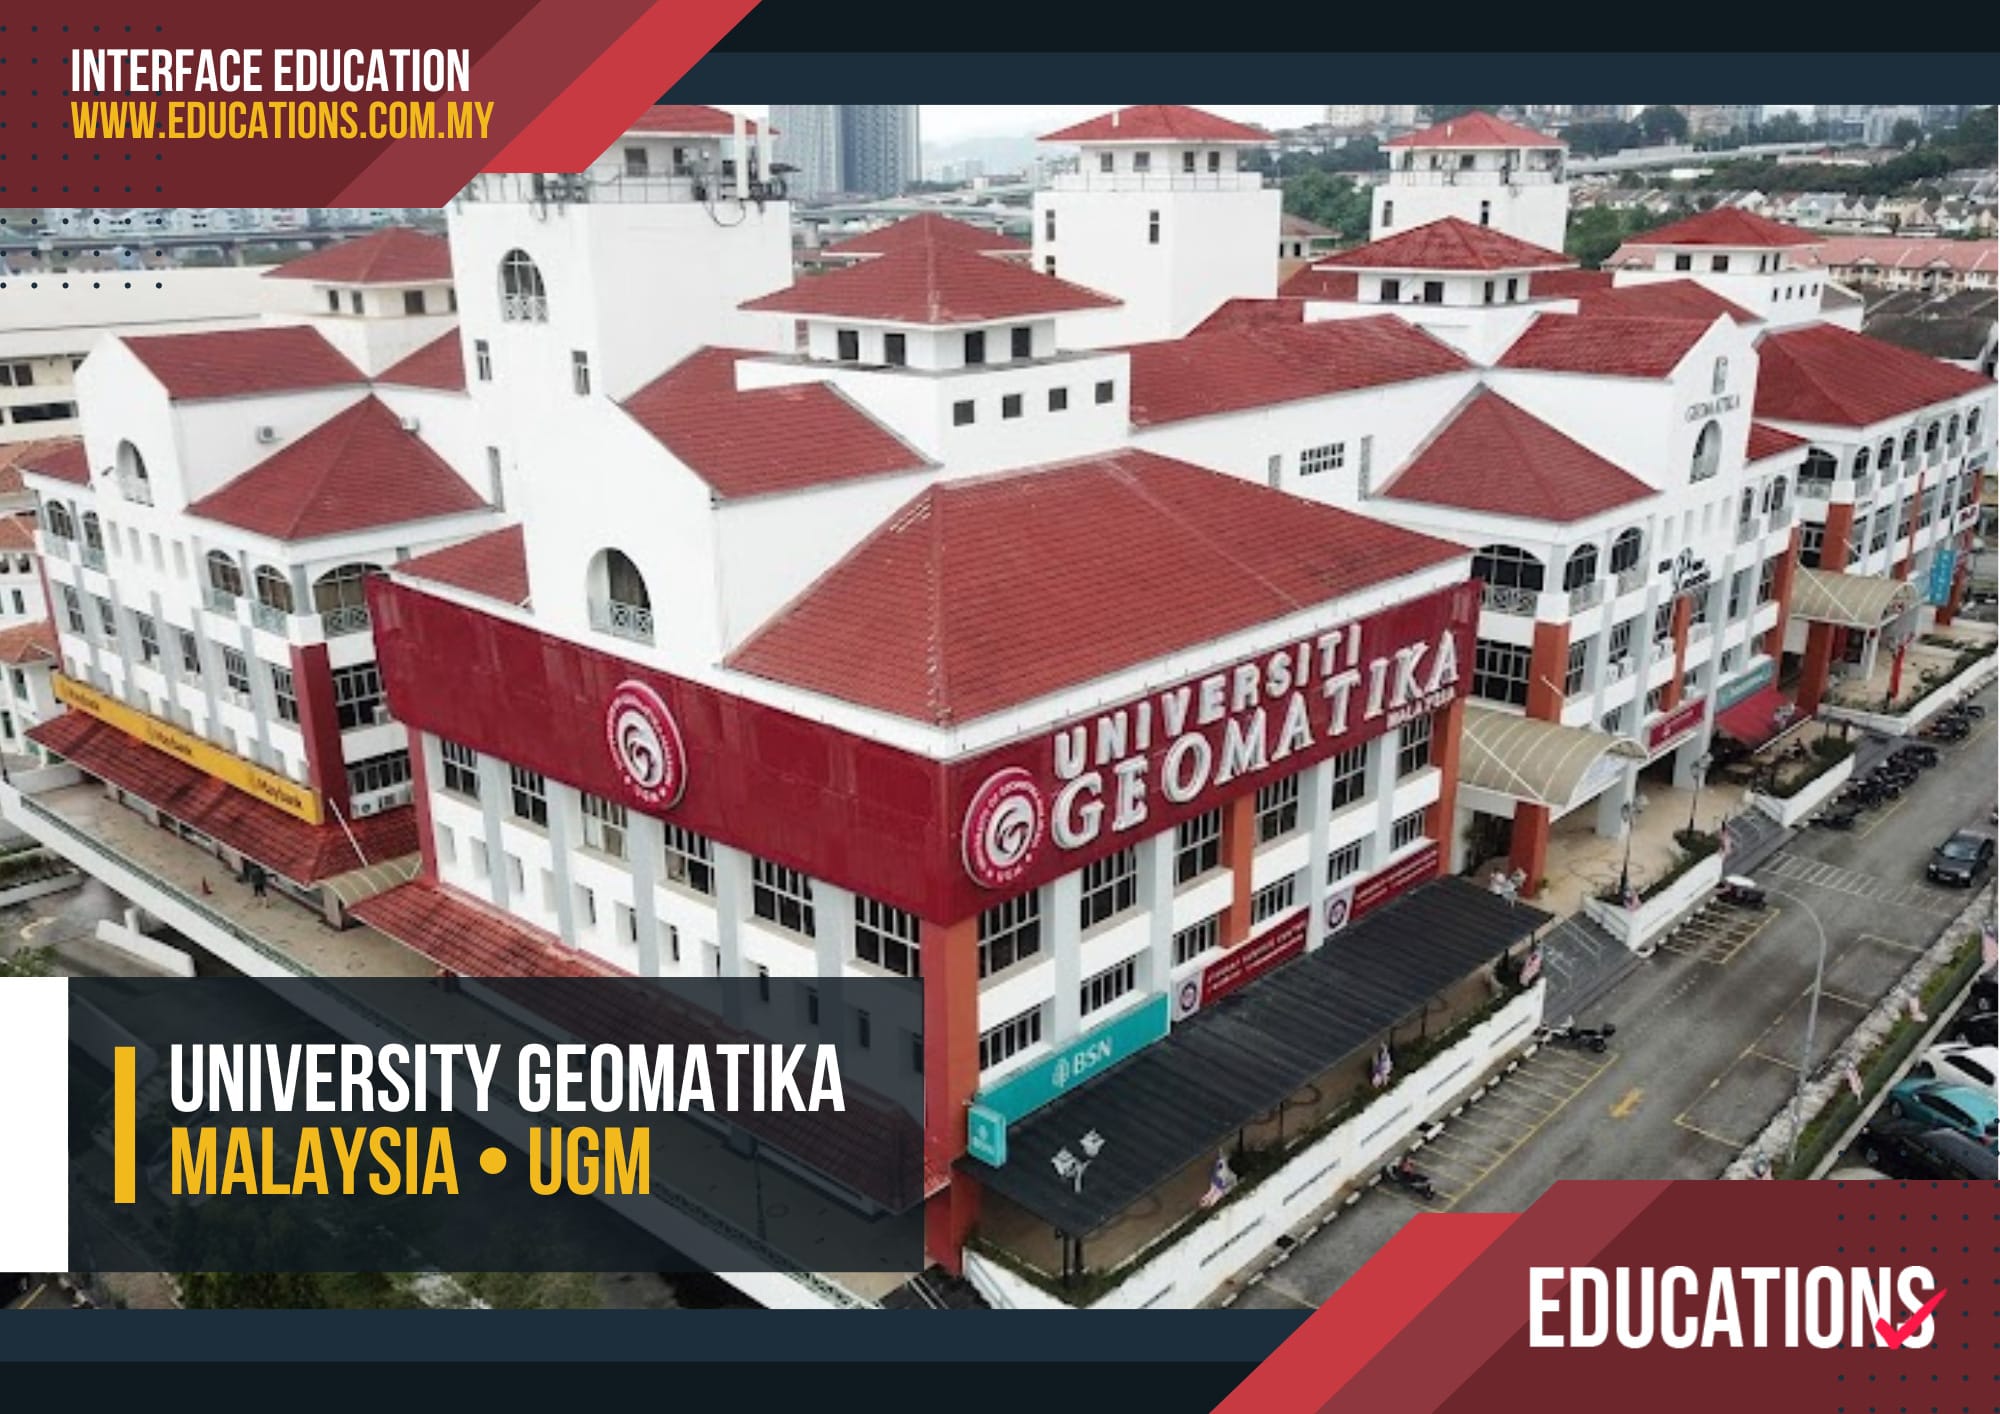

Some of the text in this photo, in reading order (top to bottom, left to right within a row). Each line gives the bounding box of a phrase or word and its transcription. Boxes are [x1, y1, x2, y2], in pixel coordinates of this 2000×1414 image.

[1051, 629, 1460, 850] GEOMATIKA
[1054, 623, 1362, 780] UNIVERSITI
[256, 777, 303, 808] Maybank
[1074, 1036, 1113, 1075] BSN
